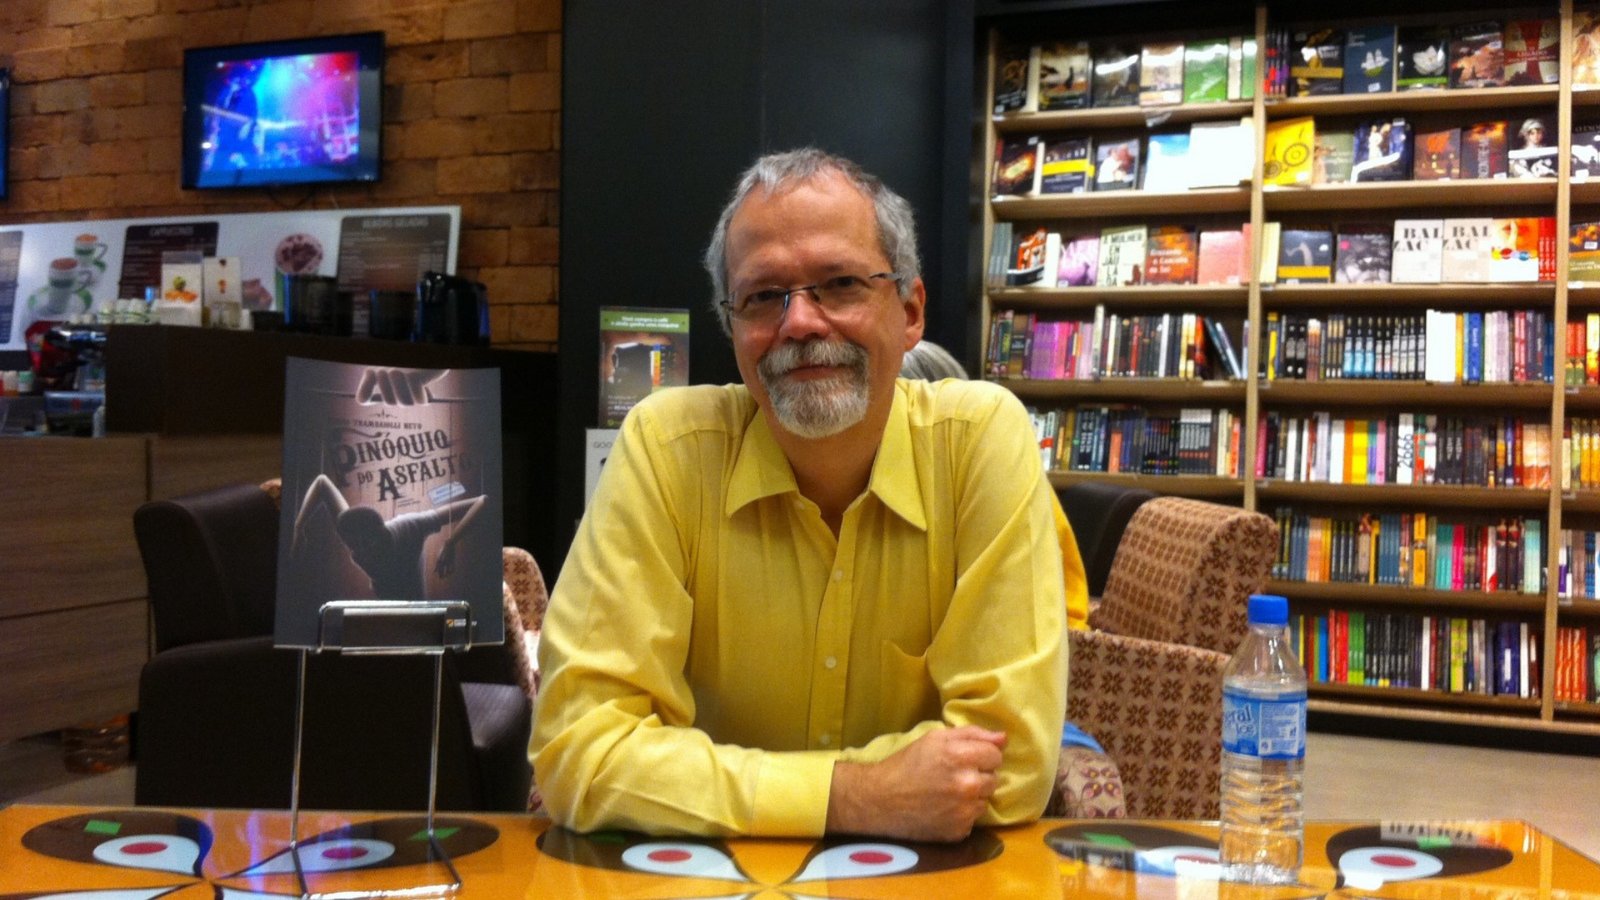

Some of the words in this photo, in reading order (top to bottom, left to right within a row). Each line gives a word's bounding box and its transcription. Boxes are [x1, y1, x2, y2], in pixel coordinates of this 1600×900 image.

[1404, 228, 1443, 239] BAL
[1453, 226, 1493, 238] BAL
[1392, 240, 1428, 252] ZAC
[334, 429, 452, 487] PINÓQUIO
[1397, 434, 1414, 469] 2666
[357, 471, 374, 485] DO
[378, 453, 471, 501] ASFALTO
